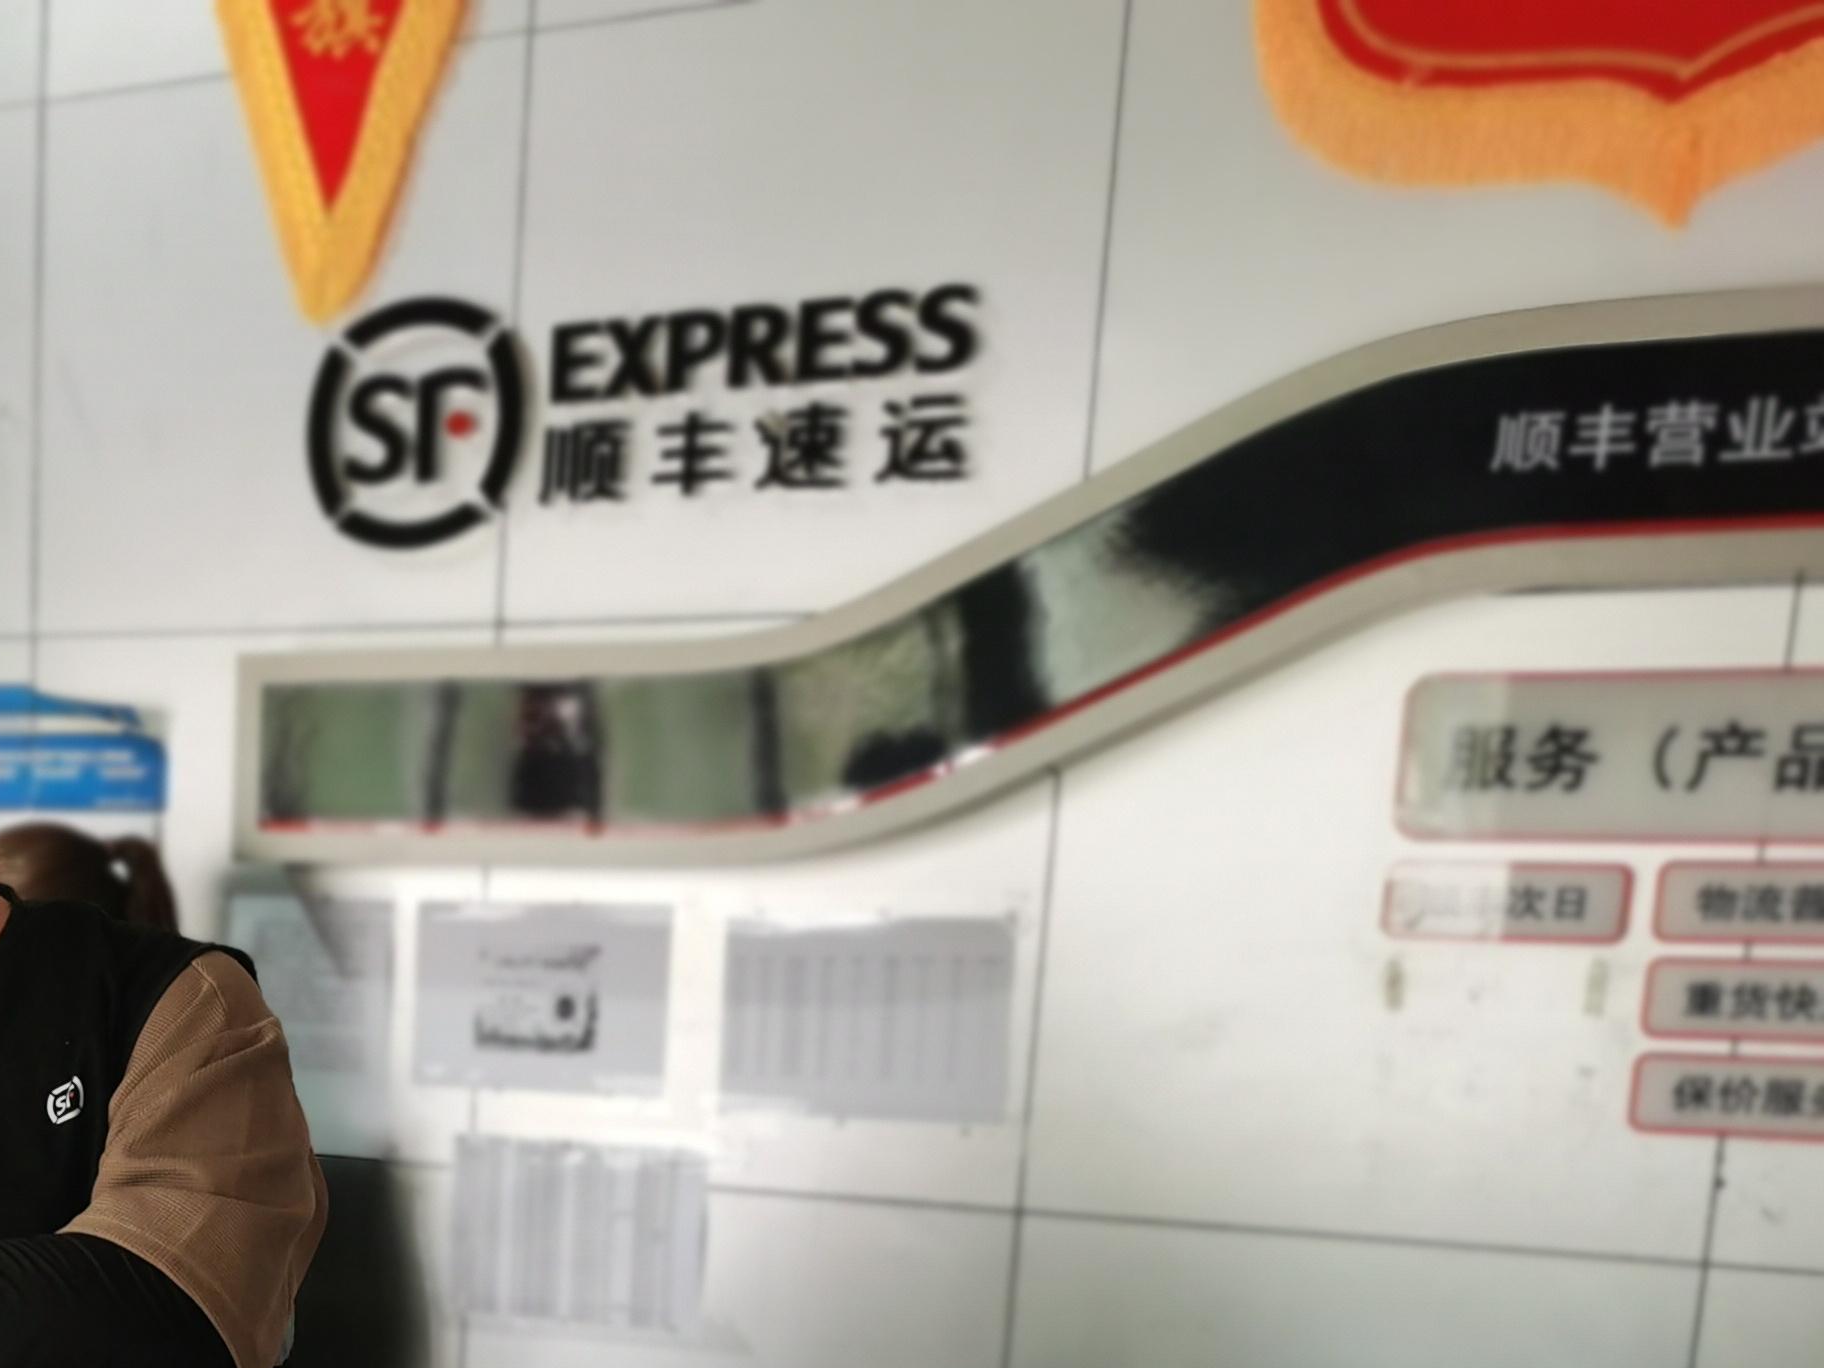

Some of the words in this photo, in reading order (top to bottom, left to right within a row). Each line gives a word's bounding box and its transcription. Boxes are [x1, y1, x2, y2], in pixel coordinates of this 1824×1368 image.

[551, 284, 981, 402] EXPRESS
[539, 398, 973, 507] 顺丰速运
[1685, 981, 1824, 1022] 重货快
[1673, 1073, 1824, 1117] 保价服
